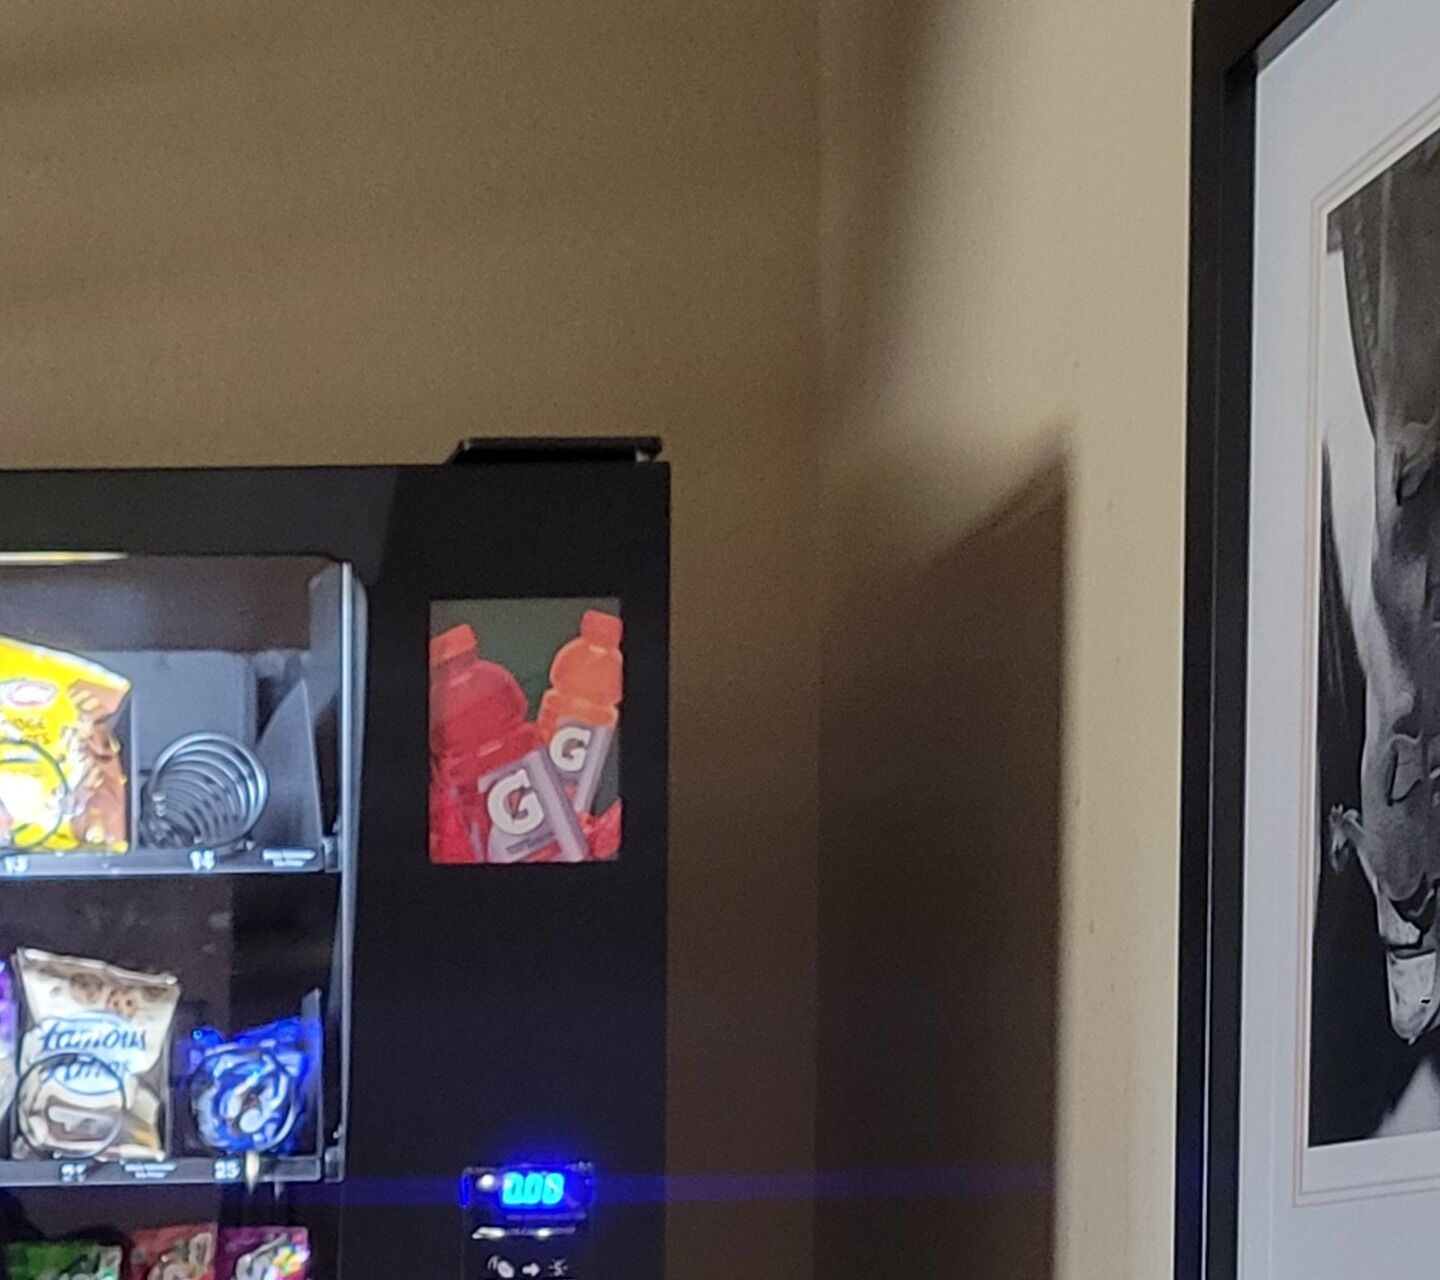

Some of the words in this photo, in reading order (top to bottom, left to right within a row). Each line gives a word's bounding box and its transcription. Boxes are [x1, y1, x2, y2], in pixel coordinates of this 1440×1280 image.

[549, 727, 591, 772] G
[487, 768, 544, 835] G
[214, 1159, 241, 1180] 25
